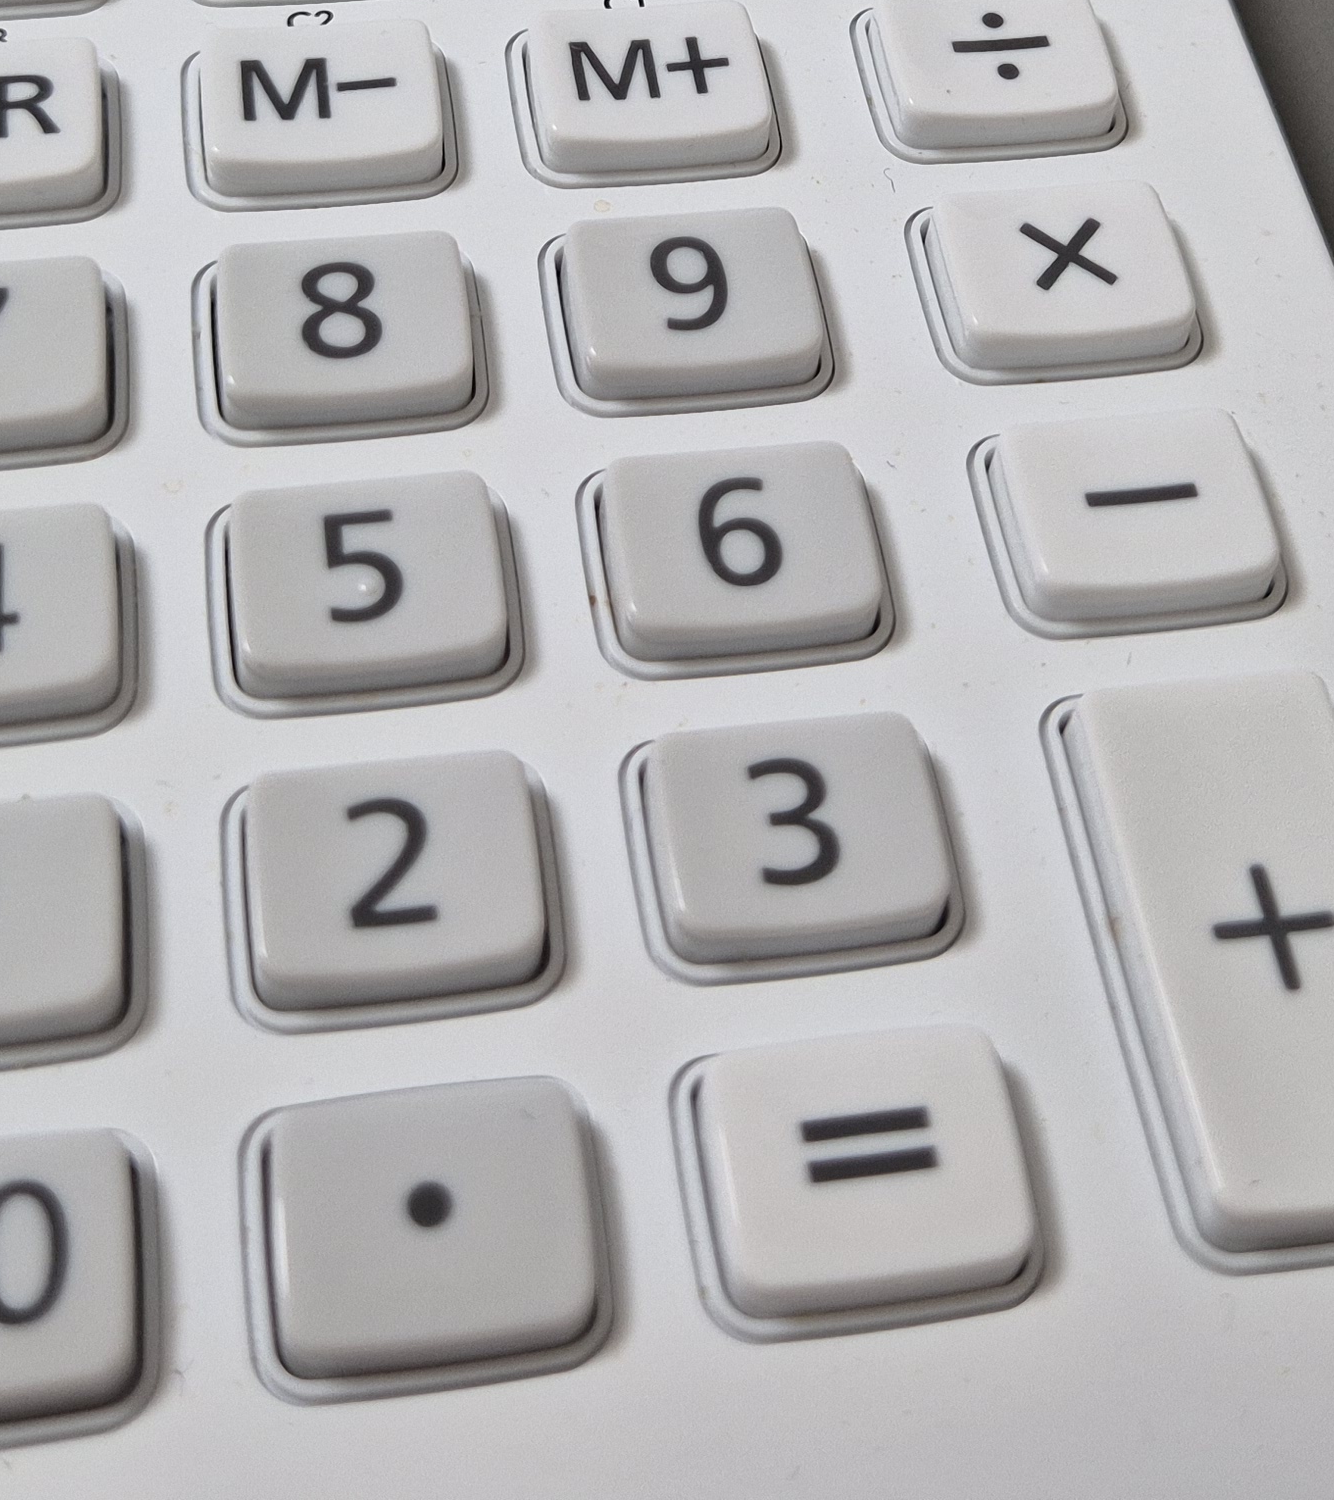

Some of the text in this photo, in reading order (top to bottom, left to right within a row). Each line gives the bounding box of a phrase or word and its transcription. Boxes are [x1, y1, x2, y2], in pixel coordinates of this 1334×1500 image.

[567, 36, 730, 102] M+
[299, 261, 383, 360] 8
[649, 236, 729, 333] 9
[322, 508, 404, 625] 5
[697, 476, 784, 588] 6
[345, 797, 439, 931] 2
[746, 757, 841, 888] 3
[799, 1106, 939, 1185] =
